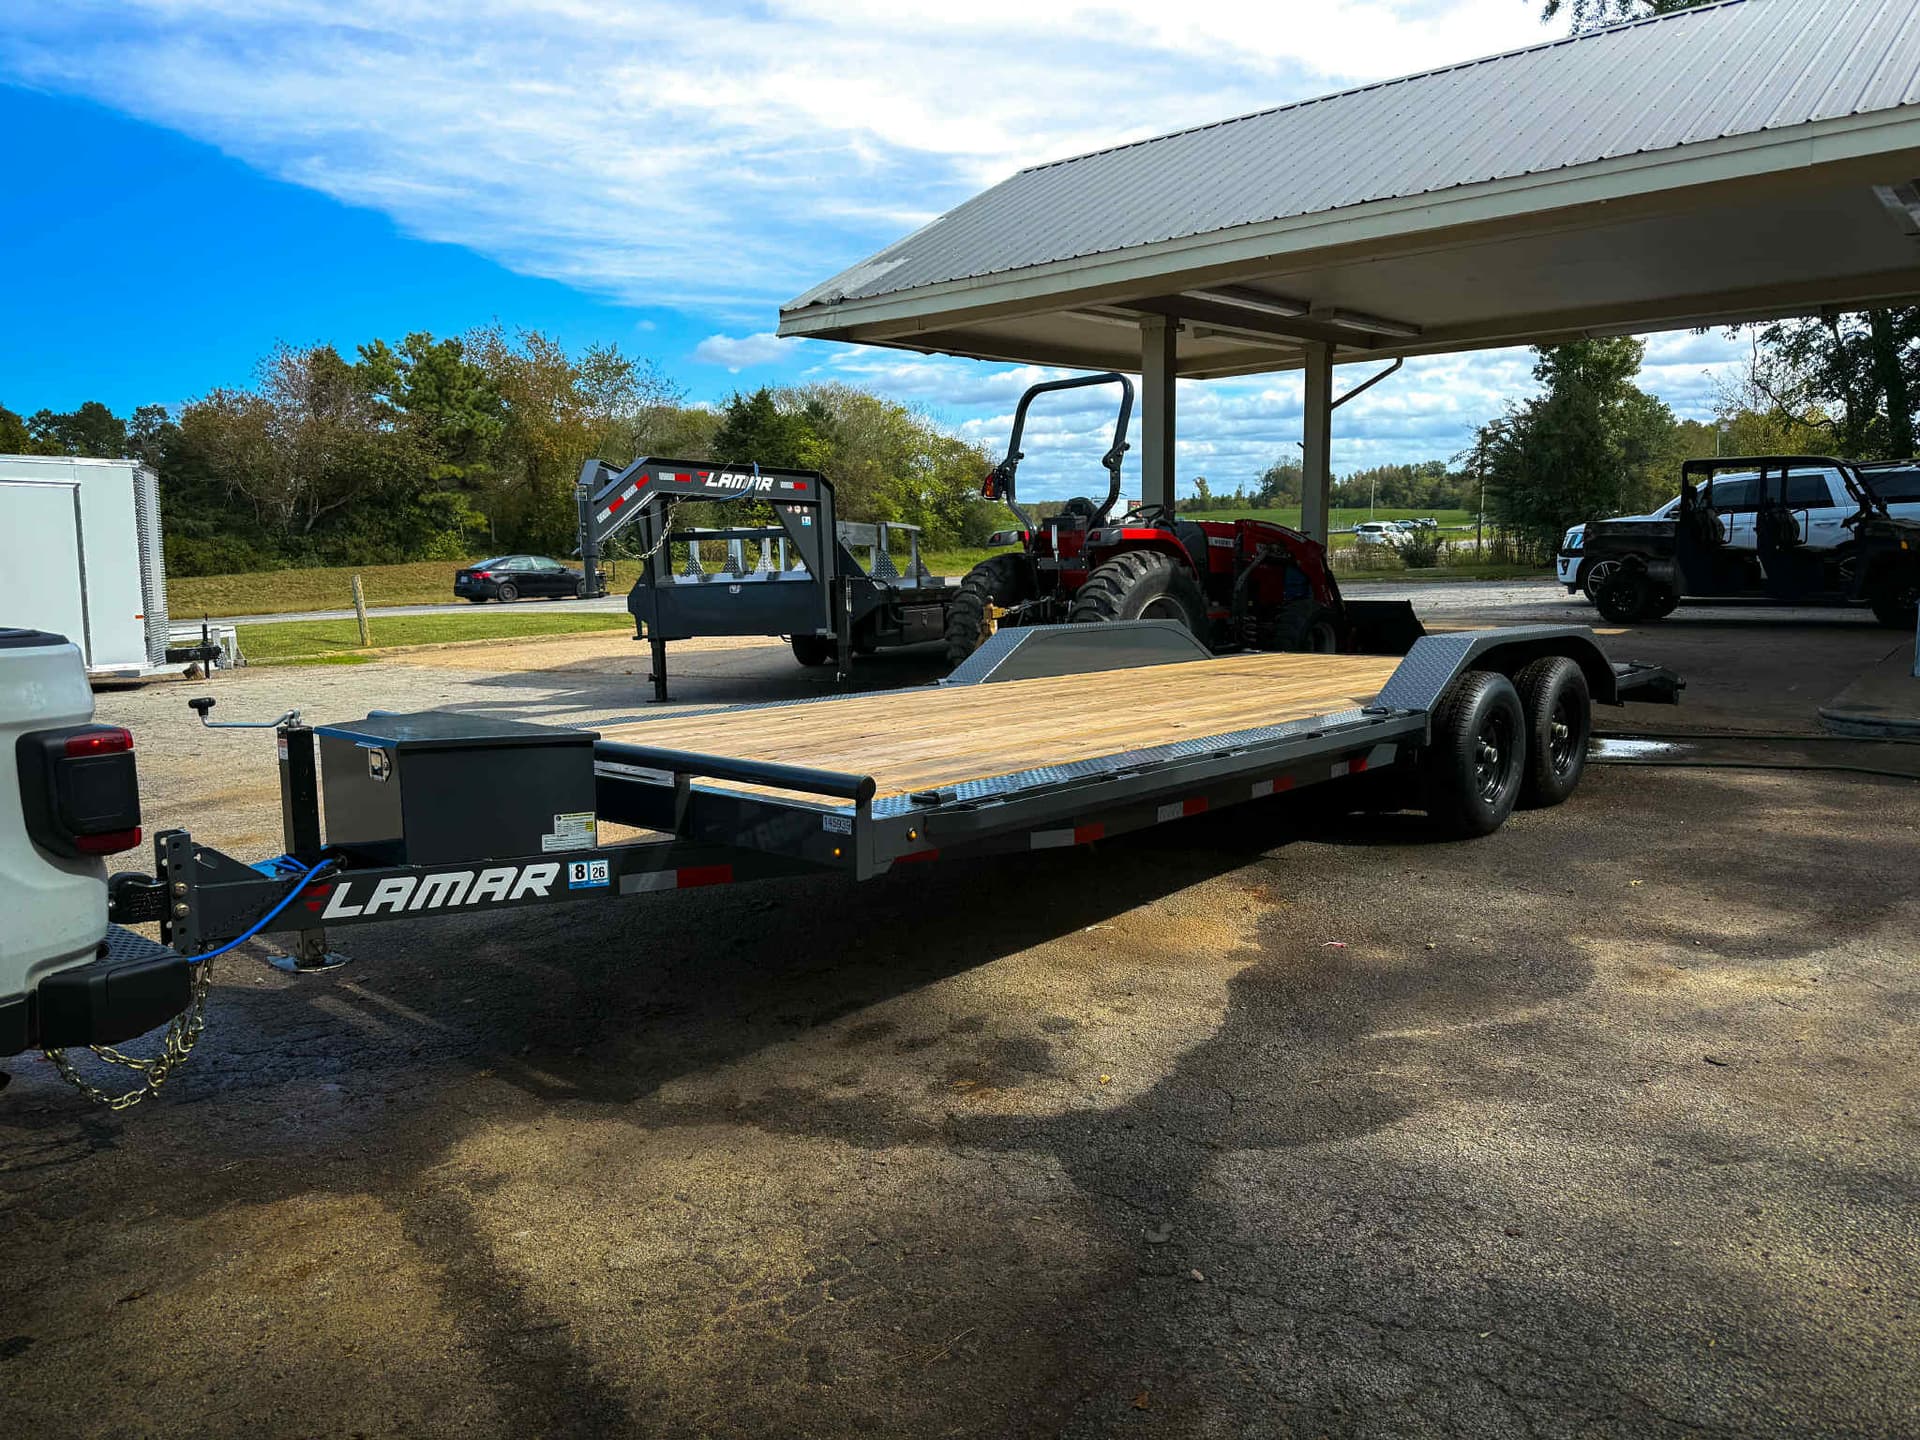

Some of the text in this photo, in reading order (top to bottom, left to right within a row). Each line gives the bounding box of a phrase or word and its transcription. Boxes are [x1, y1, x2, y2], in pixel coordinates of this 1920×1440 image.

[705, 472, 774, 490] LAMAR
[575, 864, 605, 879] 8 26
[321, 862, 561, 919] LAMAR
